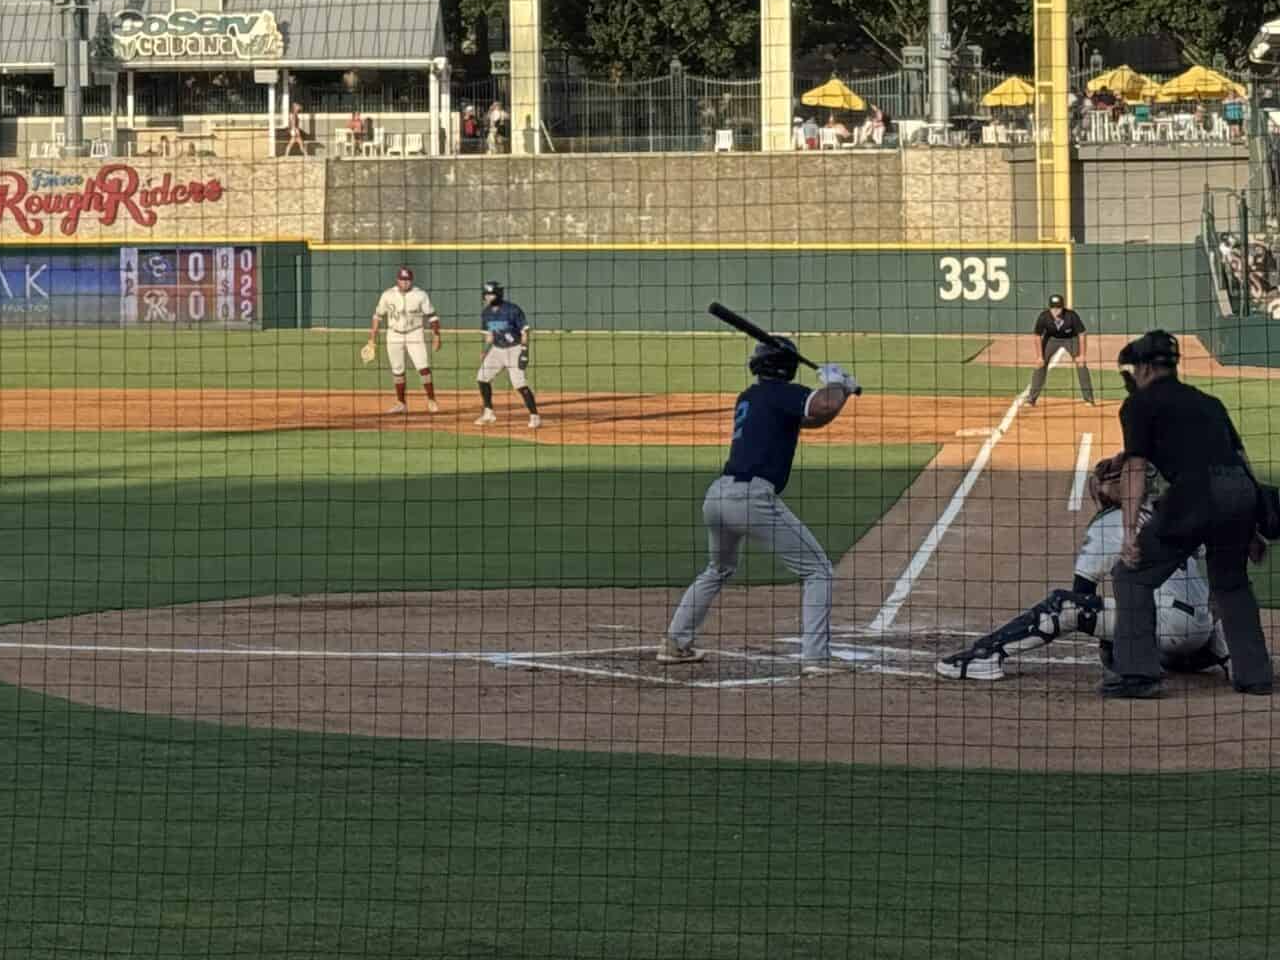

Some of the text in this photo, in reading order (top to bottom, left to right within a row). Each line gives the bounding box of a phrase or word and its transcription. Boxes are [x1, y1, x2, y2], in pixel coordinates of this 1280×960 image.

[112, 11, 258, 36] CoServ
[188, 251, 205, 282] 0
[240, 249, 253, 273] 0
[240, 275, 253, 297] 2
[938, 256, 1010, 302] 335
[188, 290, 205, 321] 0
[240, 300, 253, 321] 2
